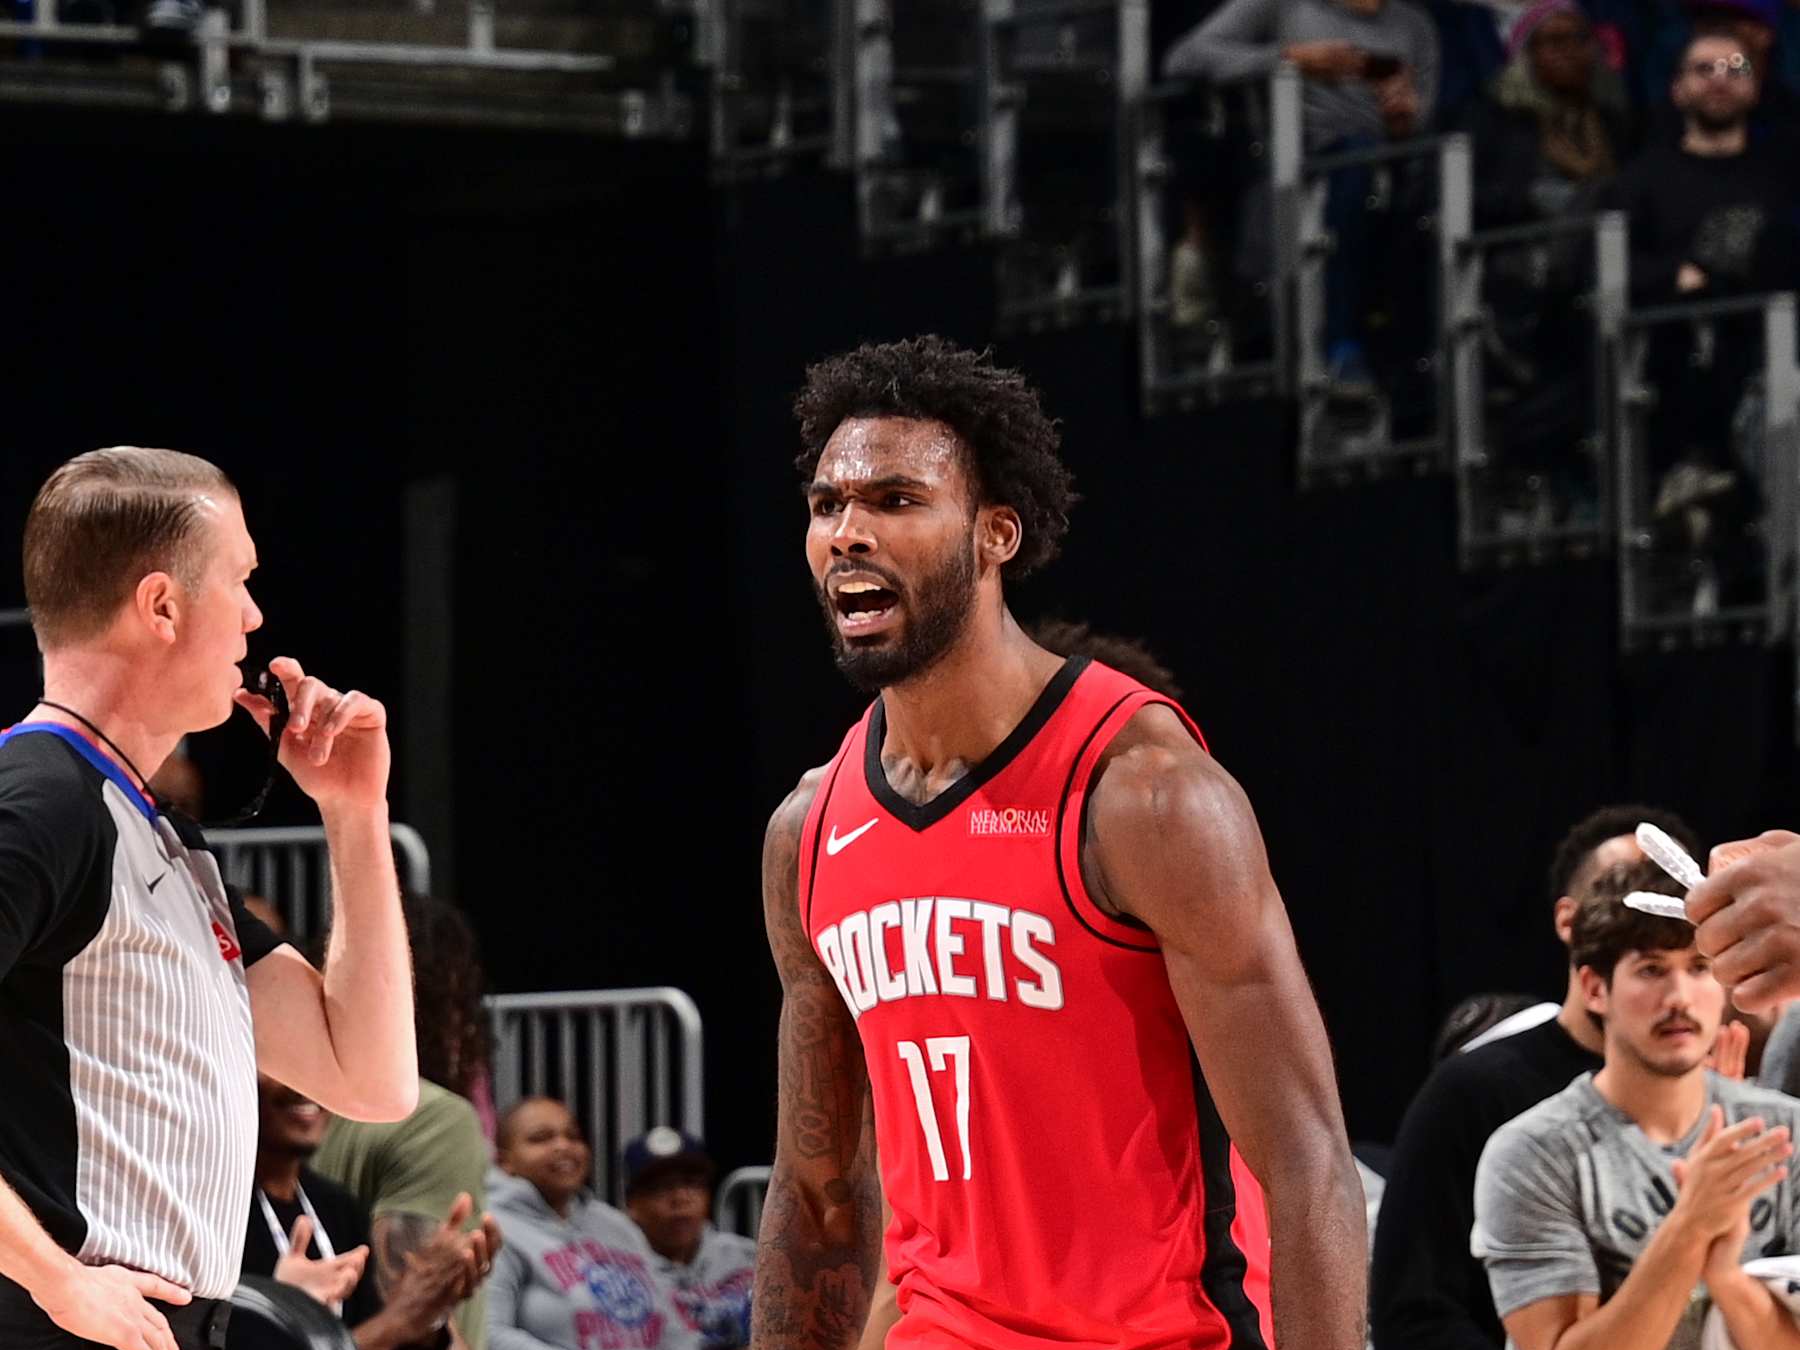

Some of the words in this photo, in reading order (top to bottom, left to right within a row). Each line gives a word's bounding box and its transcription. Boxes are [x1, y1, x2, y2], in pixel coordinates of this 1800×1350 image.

[970, 808, 1049, 824] MEMORIAL
[970, 820, 1048, 835] HERMANN
[816, 895, 1065, 1022] ROCKETS
[896, 1035, 972, 1182] 17
